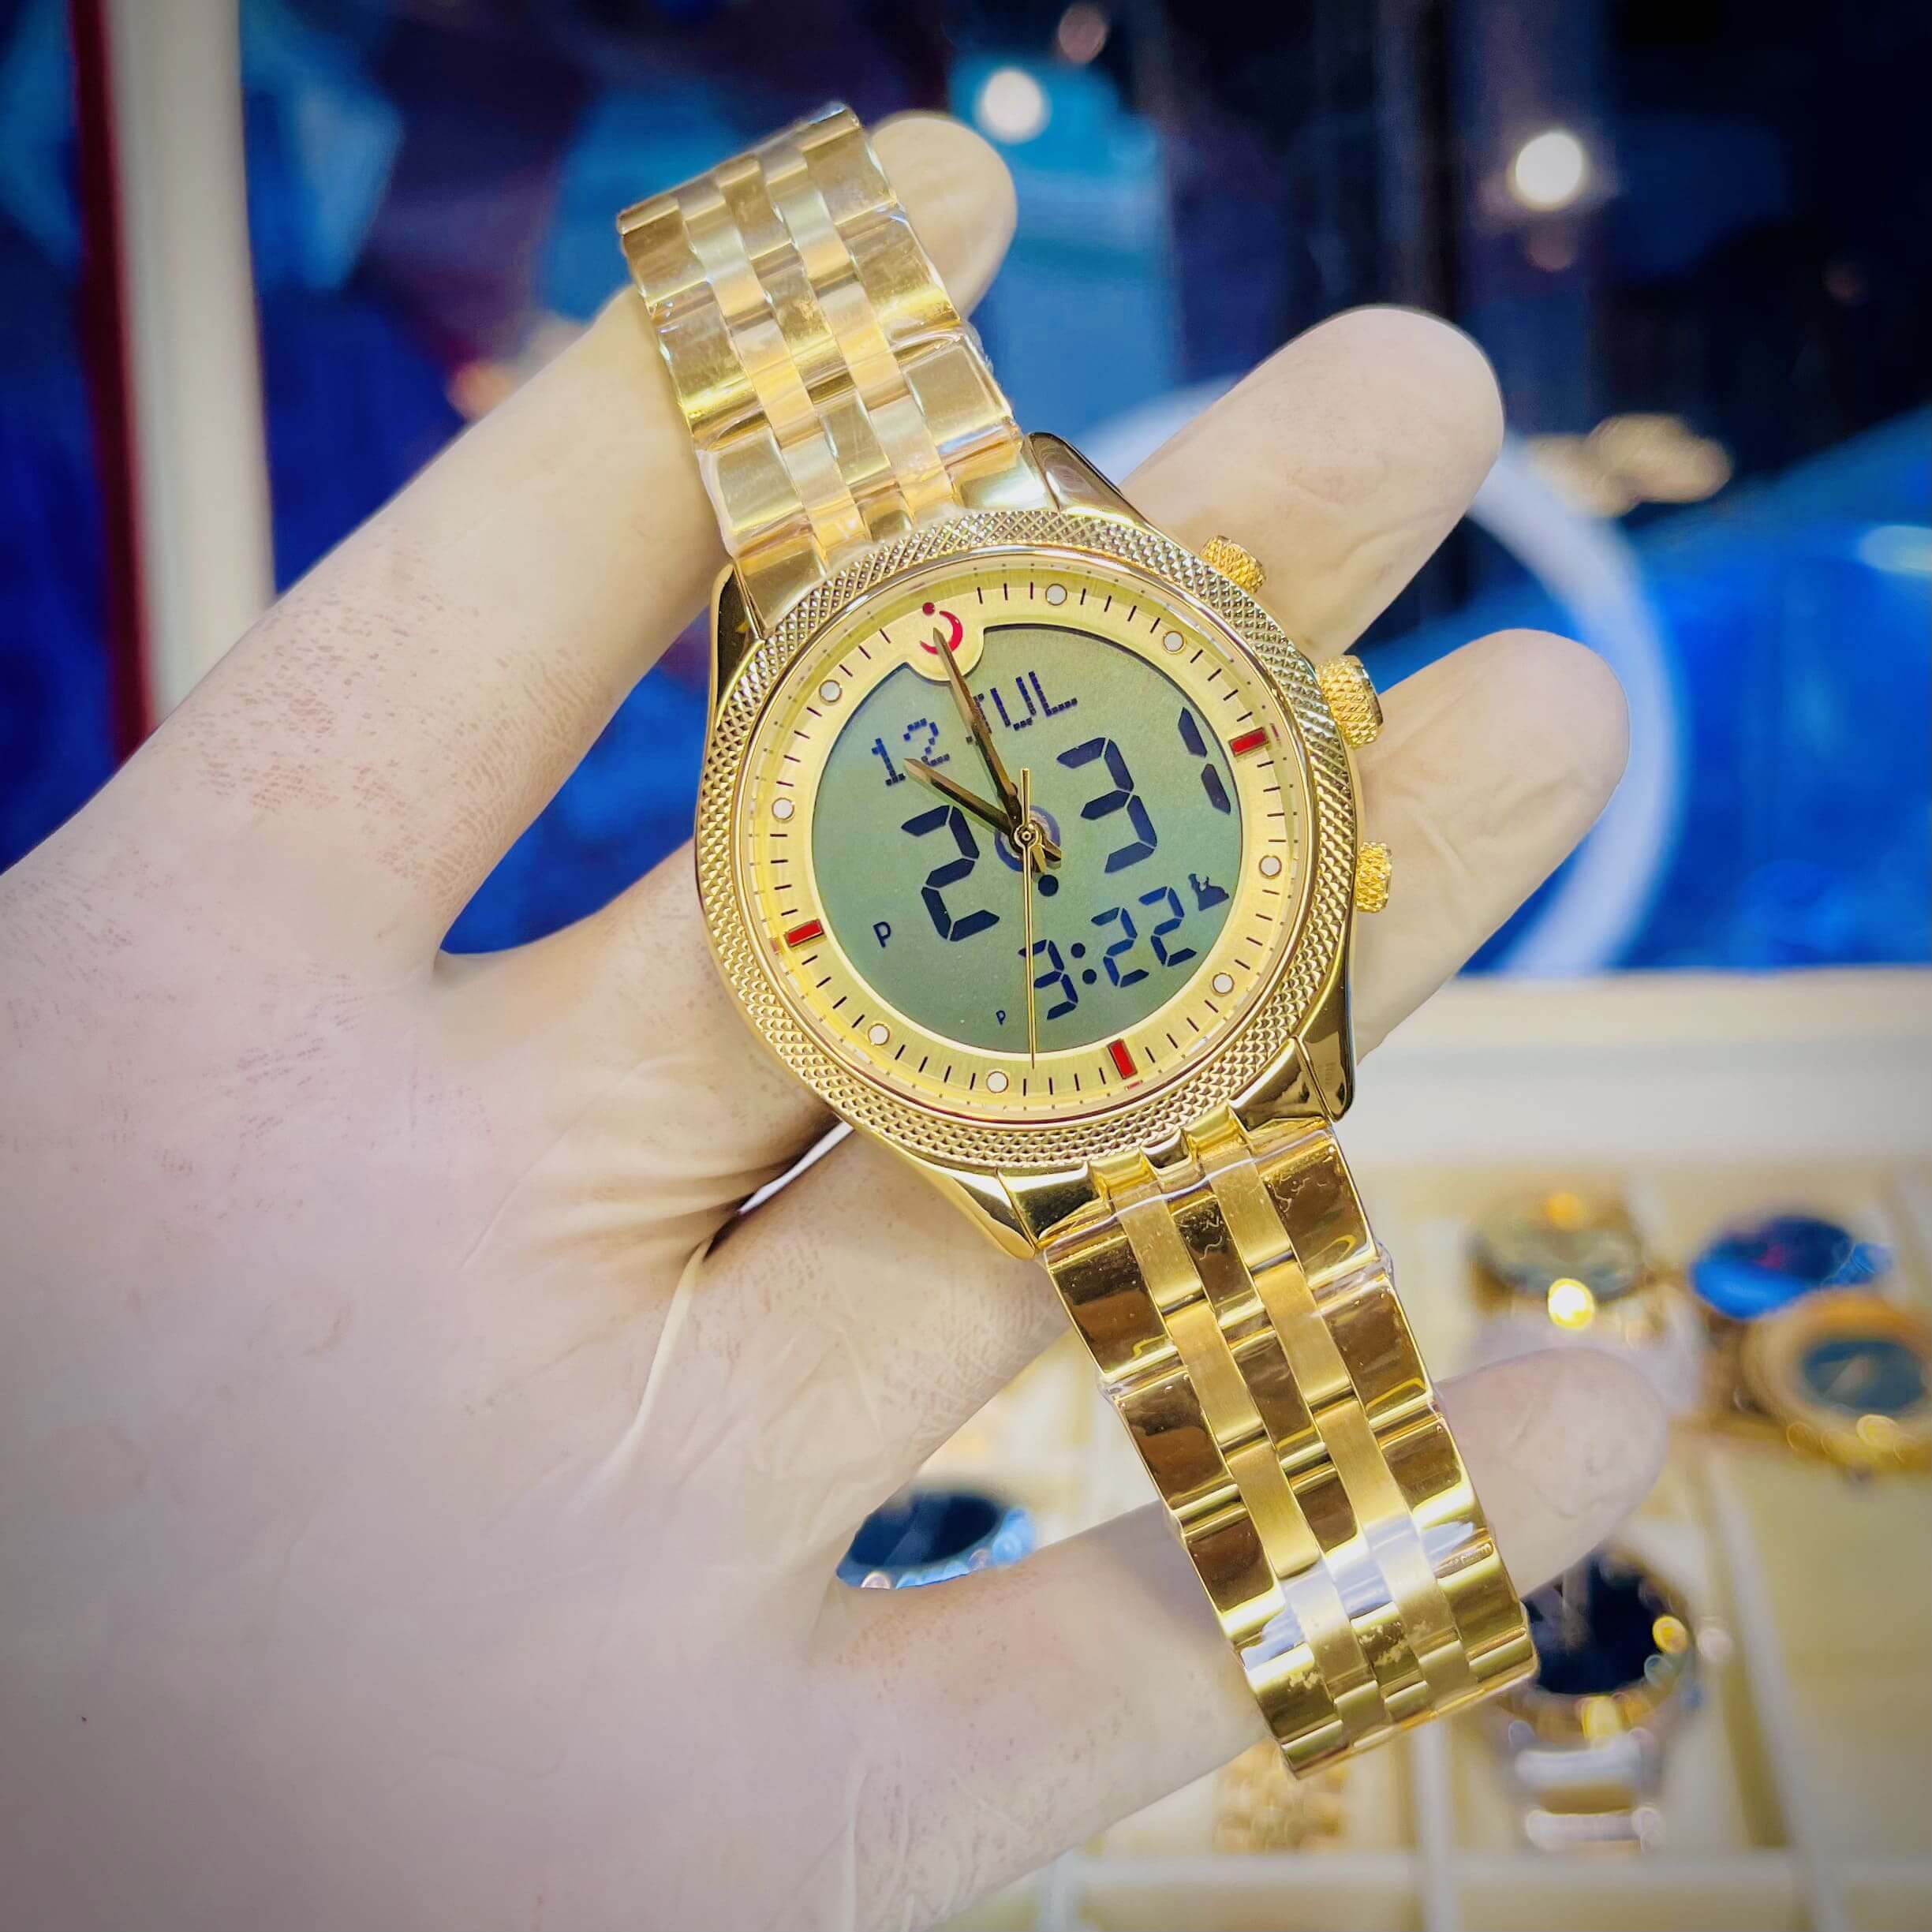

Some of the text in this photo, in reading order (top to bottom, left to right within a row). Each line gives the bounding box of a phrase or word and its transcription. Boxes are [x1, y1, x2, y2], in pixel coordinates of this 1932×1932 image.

[871, 718, 951, 787] 12
[872, 921, 892, 948] P
[1017, 886, 1198, 1021] 3:22
